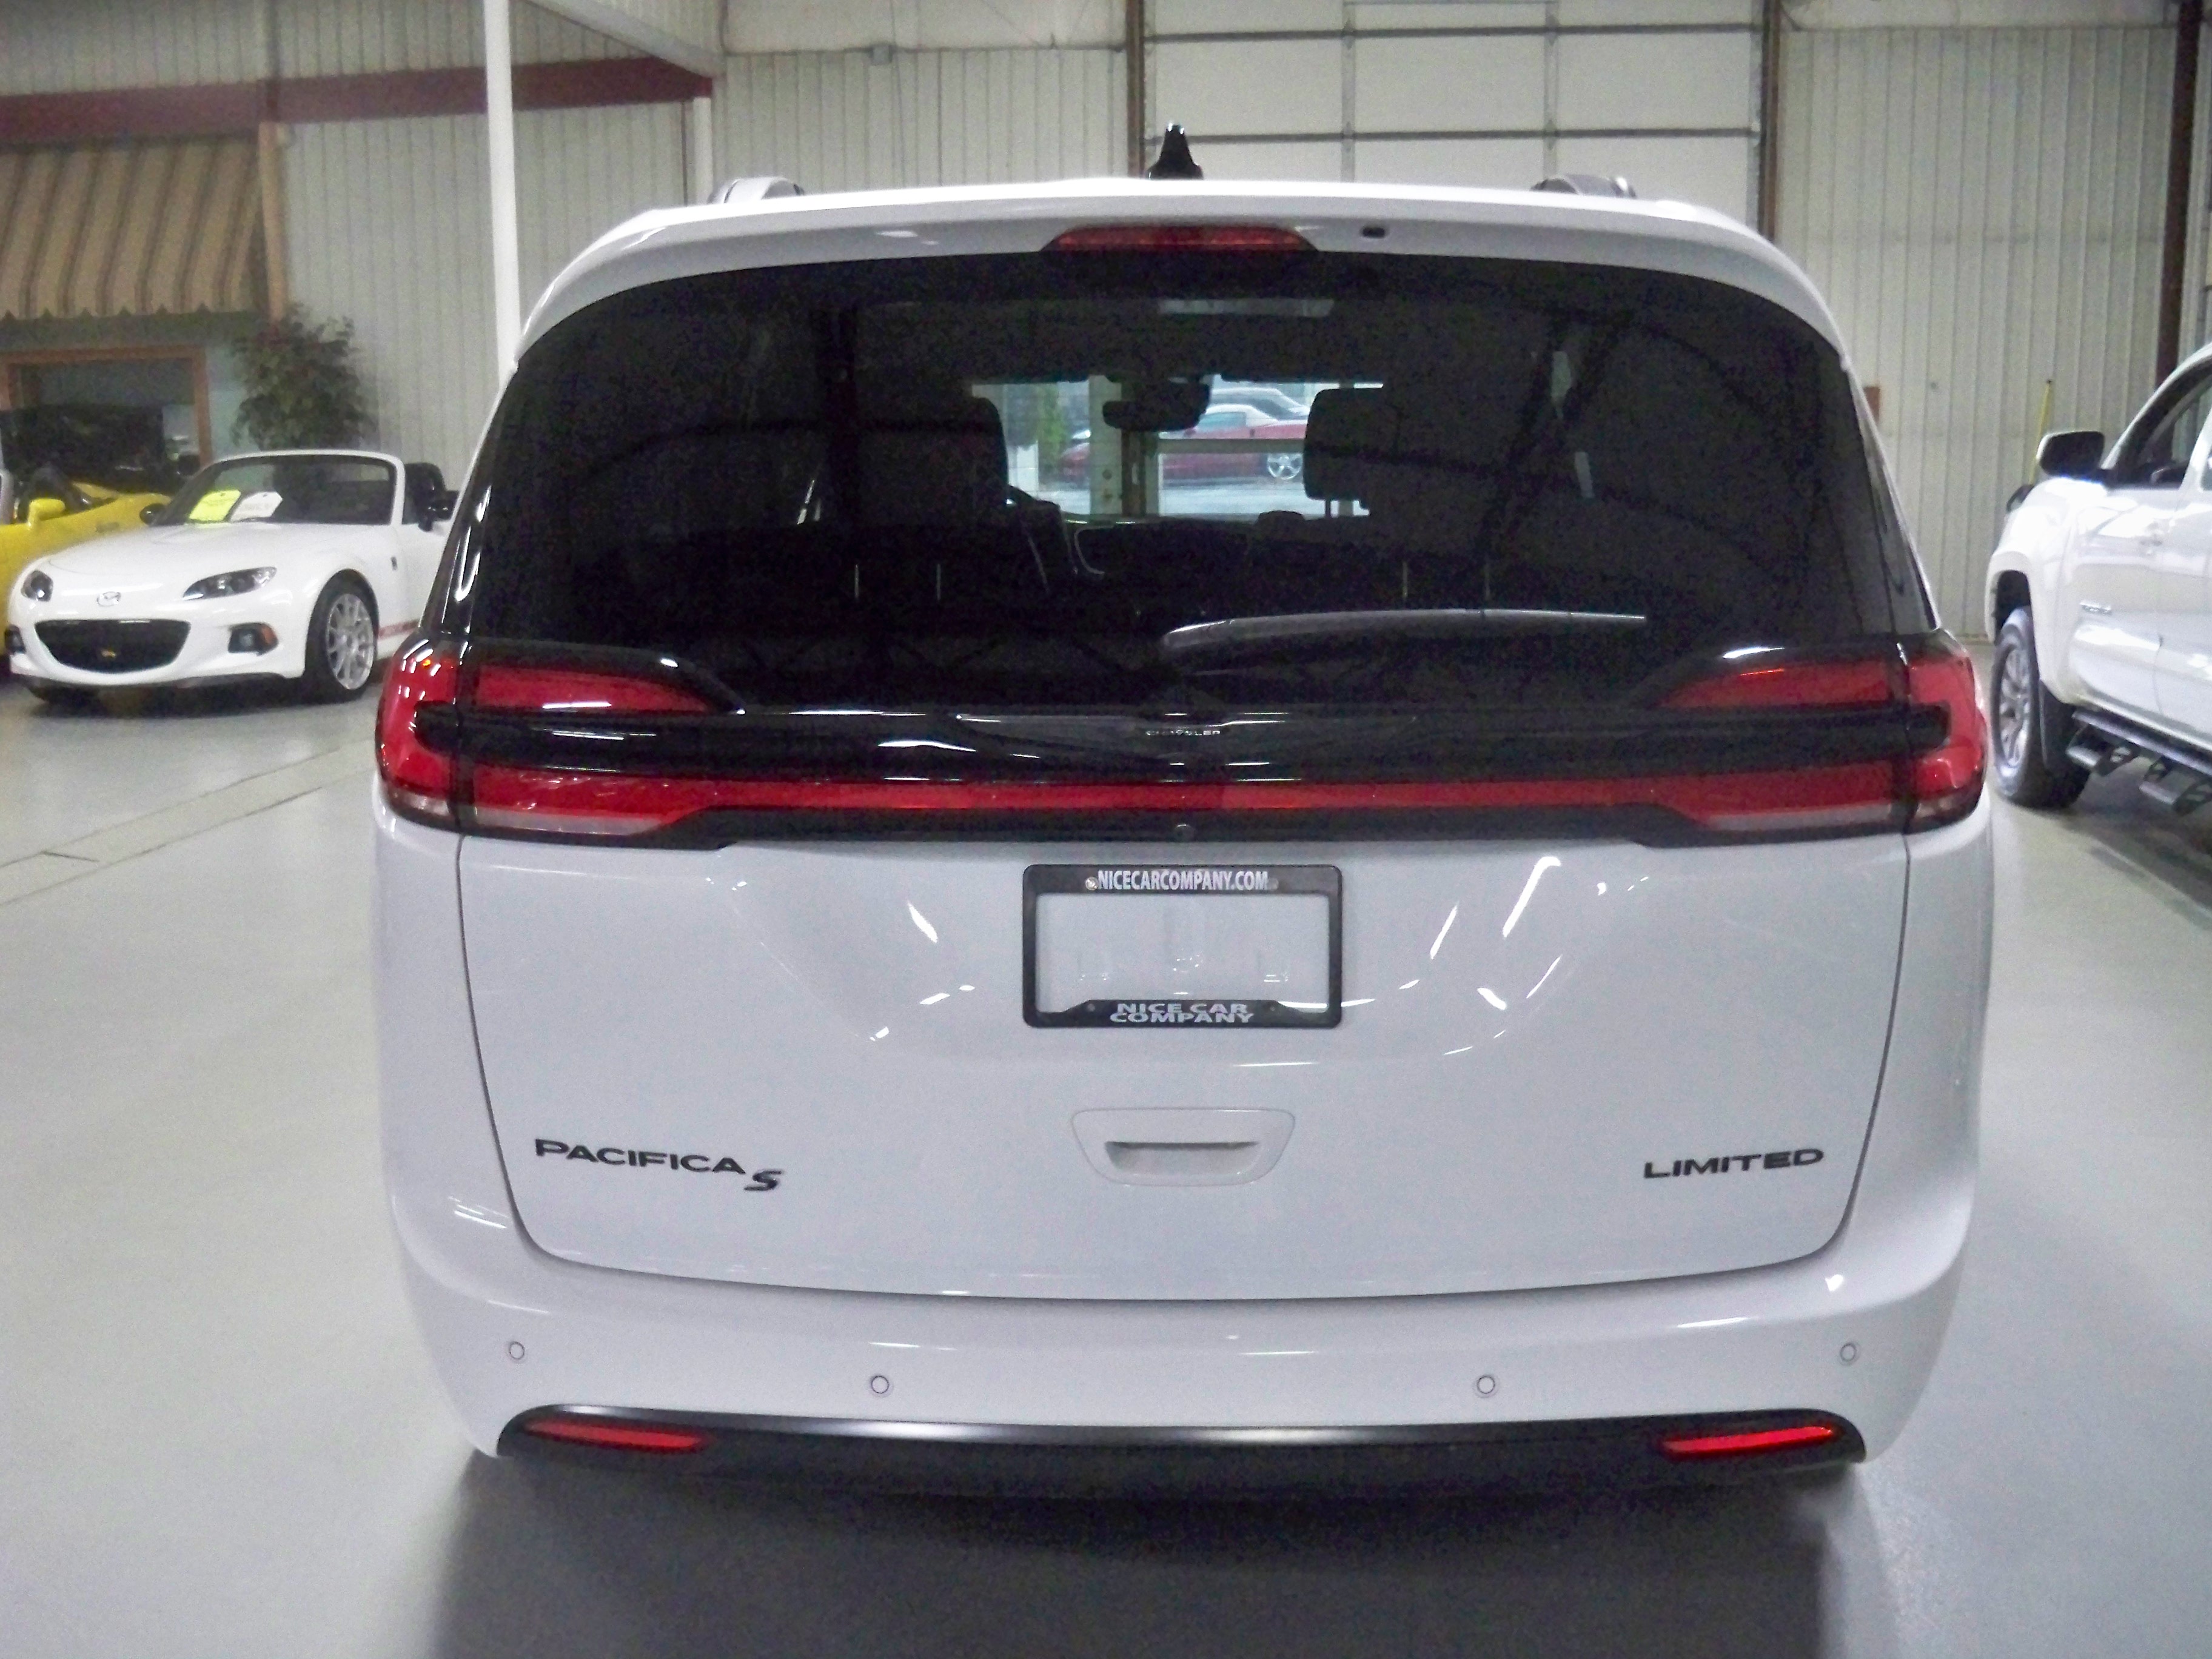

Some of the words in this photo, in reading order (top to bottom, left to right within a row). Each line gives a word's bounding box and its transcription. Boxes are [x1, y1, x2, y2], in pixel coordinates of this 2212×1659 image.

[1098, 870, 1268, 890] NICECARCOMPANY.COM
[1110, 1013, 1253, 1023] COMPANY
[1117, 1004, 1182, 1013] NICE
[1190, 1004, 1247, 1013] CAR
[535, 1139, 745, 1175] PACIFICA
[744, 1169, 783, 1191] S
[1643, 1148, 1825, 1179] LIMITED
